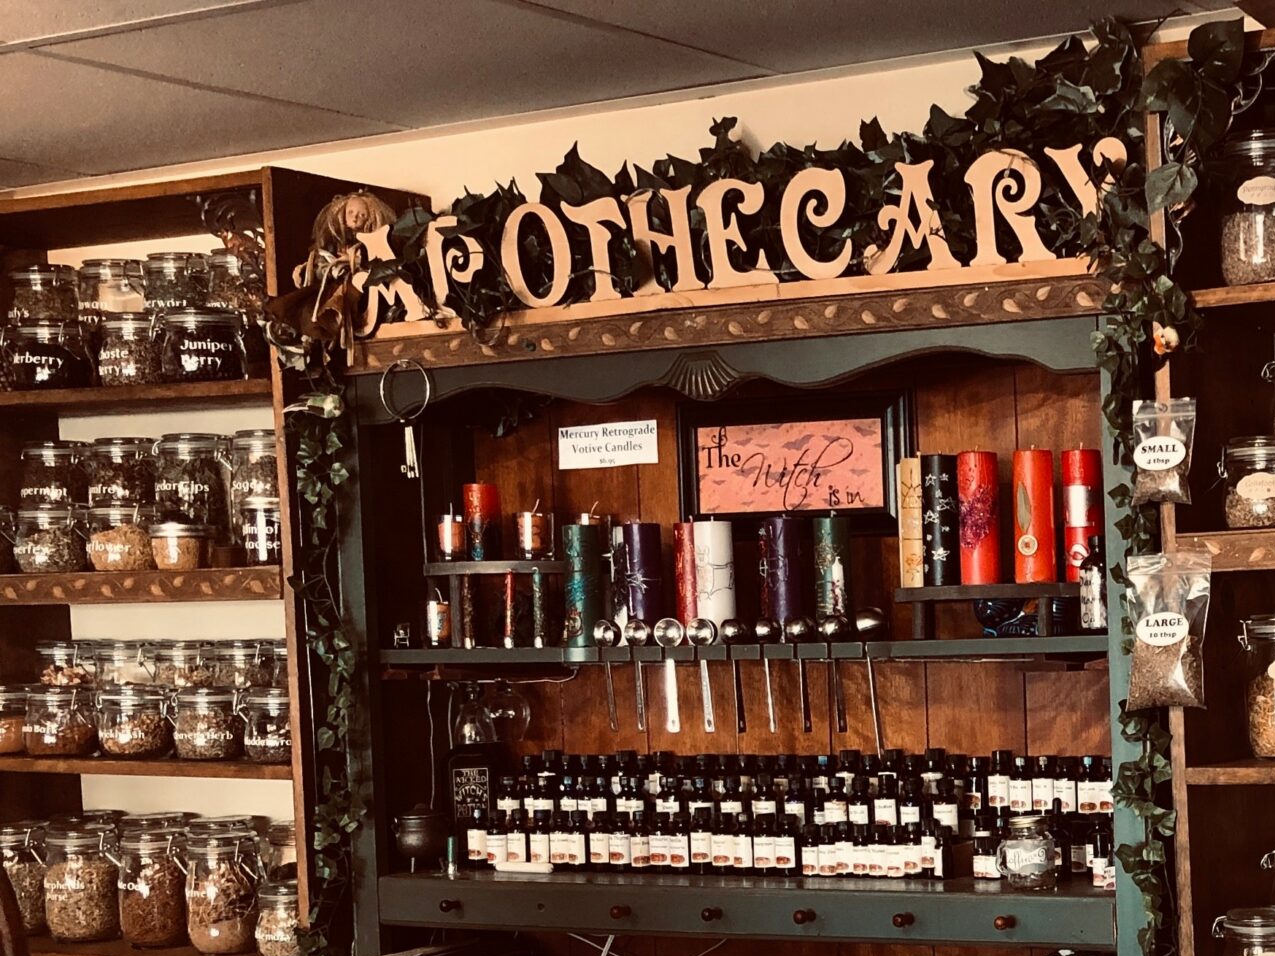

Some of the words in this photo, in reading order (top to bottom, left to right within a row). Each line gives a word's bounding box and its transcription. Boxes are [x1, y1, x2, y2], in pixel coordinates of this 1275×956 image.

[353, 136, 1127, 337] APOTHECARY
[559, 426, 601, 441] Mercury
[601, 424, 656, 438] Retrograde
[572, 442, 603, 454] Votive
[604, 440, 643, 452] Candles
[702, 426, 742, 470] The
[1140, 443, 1179, 455] SMALL
[740, 436, 854, 512] Witch
[1145, 616, 1184, 629] LARGE
[1160, 630, 1178, 641] tbsp
